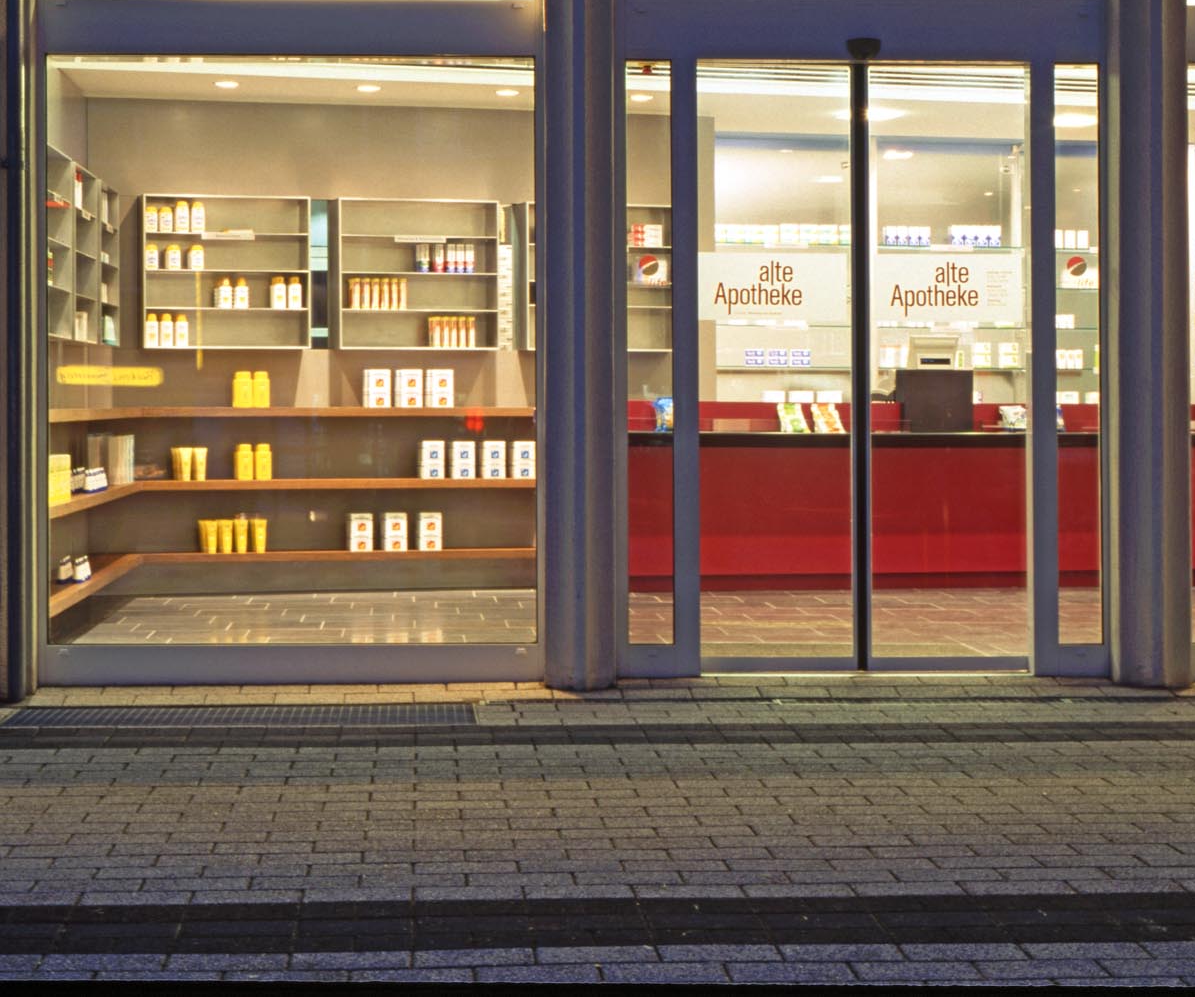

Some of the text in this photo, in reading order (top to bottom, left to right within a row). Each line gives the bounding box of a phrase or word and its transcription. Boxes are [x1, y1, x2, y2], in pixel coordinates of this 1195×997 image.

[759, 260, 793, 286] alte
[935, 261, 969, 287] alte
[714, 282, 803, 316] Apotheke
[890, 284, 979, 317] Apotheke
